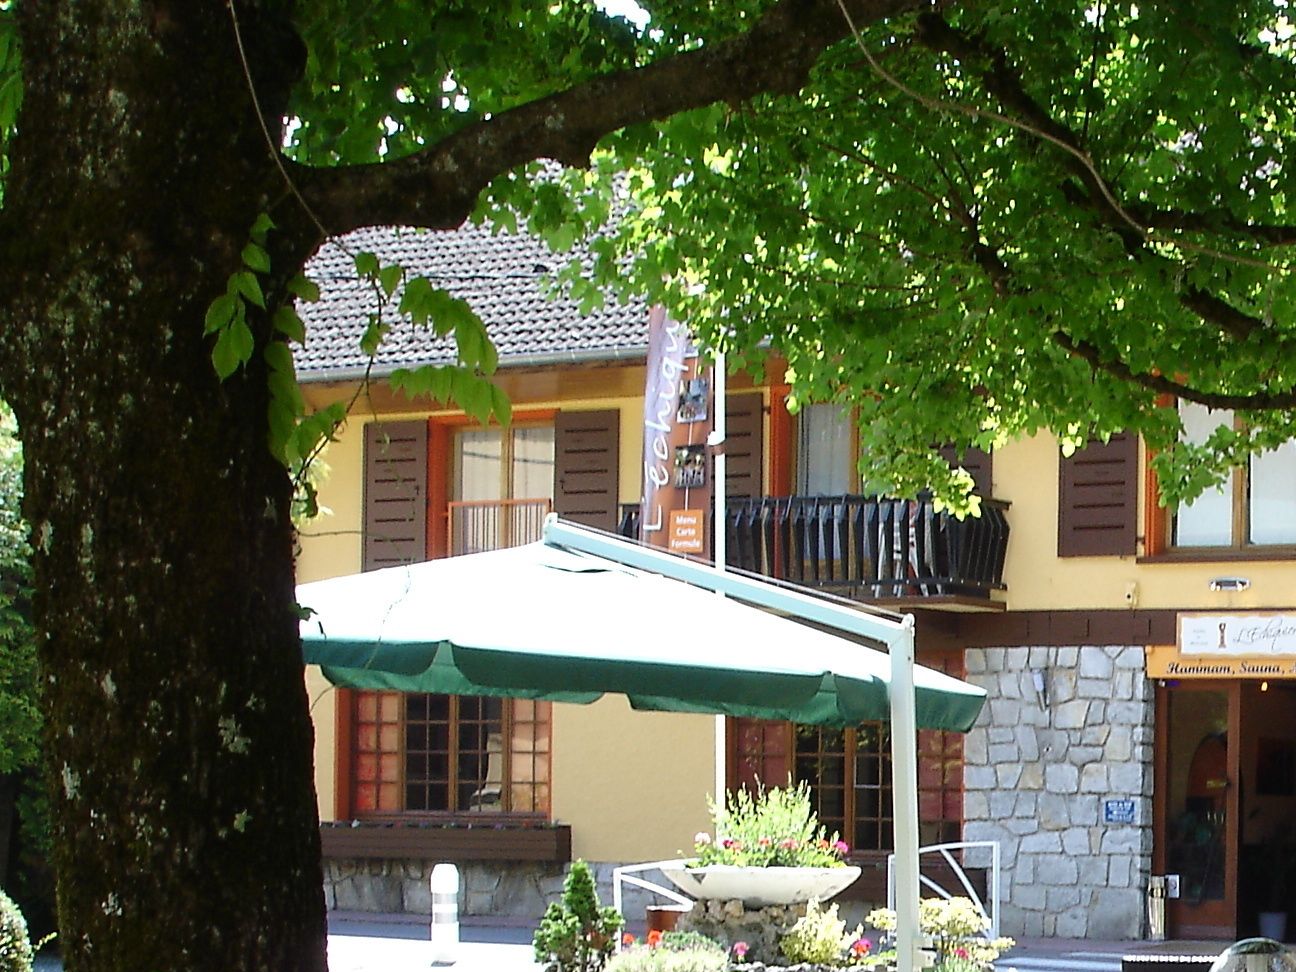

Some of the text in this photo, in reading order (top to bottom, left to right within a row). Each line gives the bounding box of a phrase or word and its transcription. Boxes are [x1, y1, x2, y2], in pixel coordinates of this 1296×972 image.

[676, 515, 697, 525] Menu
[676, 527, 696, 537] Carte
[1167, 661, 1235, 675] Hammam,
[1239, 660, 1285, 674] Sauna,
